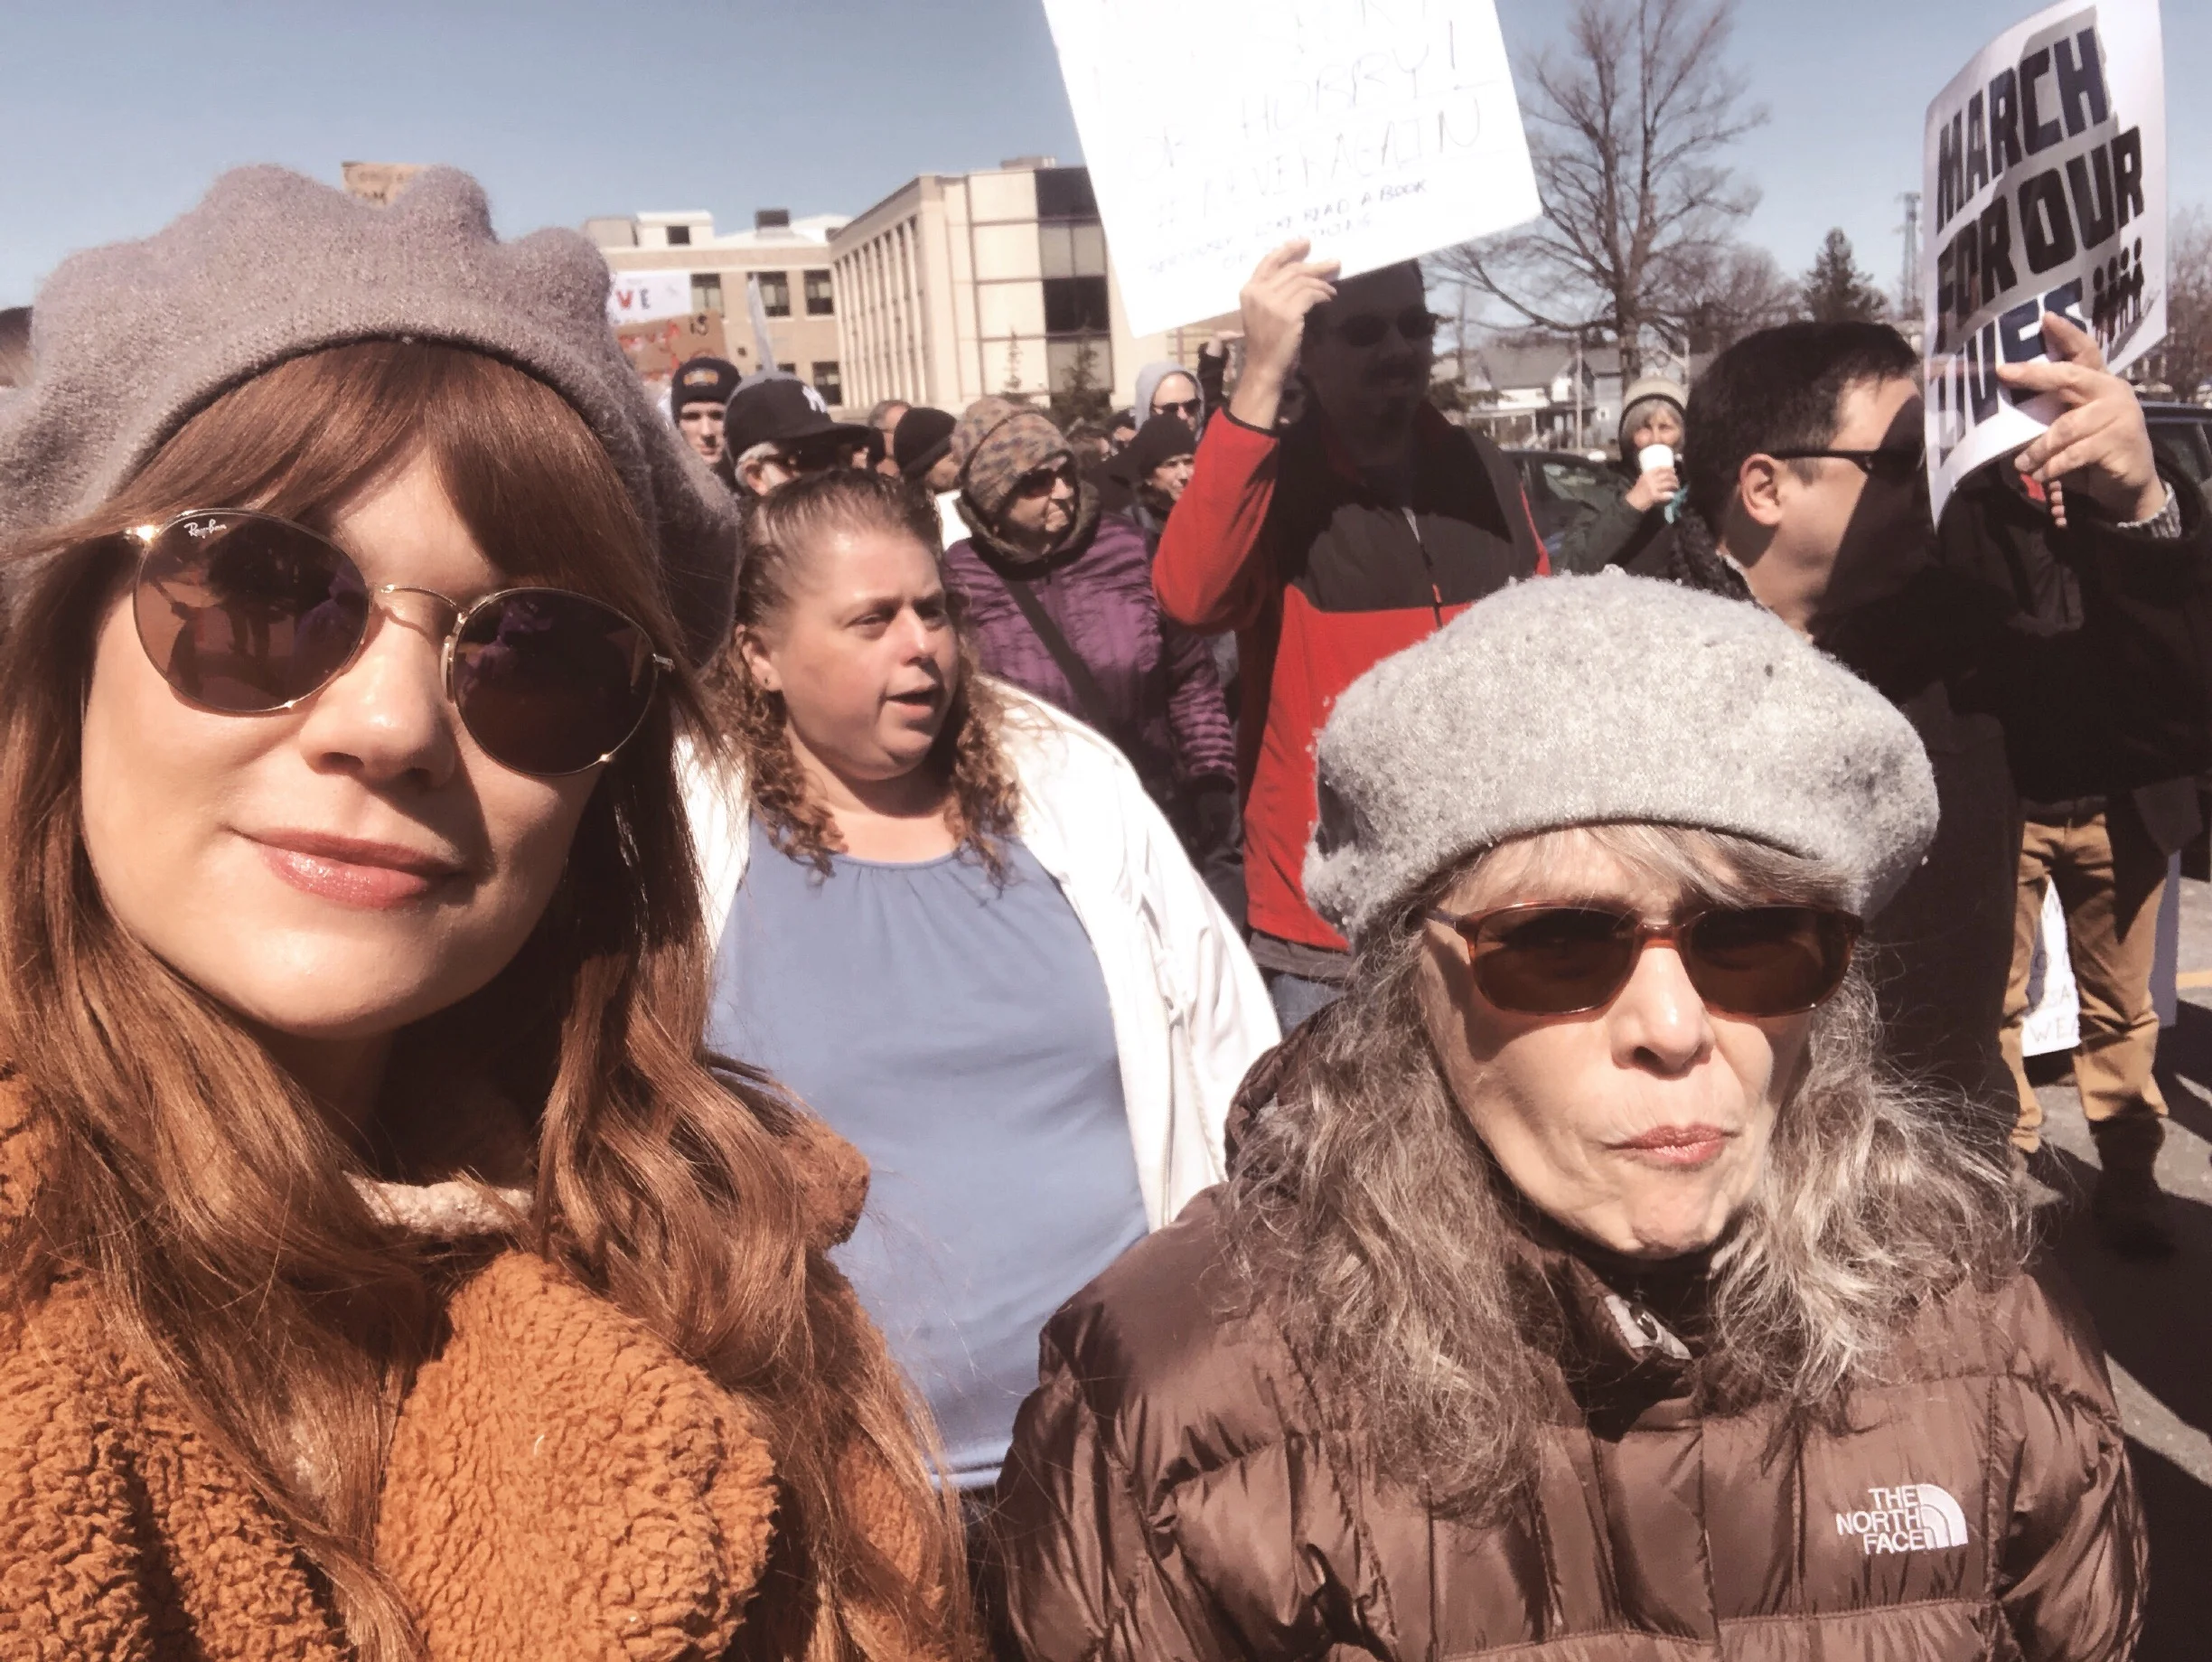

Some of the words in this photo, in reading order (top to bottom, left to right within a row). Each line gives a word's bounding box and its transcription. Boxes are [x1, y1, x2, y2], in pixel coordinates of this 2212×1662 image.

[1936, 26, 2109, 236] MARCH
[1379, 178, 1430, 203] BOOK
[1936, 193, 2019, 354] FOR
[2018, 125, 2145, 276] OUR
[183, 519, 228, 539] Ray-Ban
[1867, 1485, 1919, 1510] THE
[1835, 1507, 1922, 1536] NORTH
[1862, 1528, 1927, 1555] FACE
